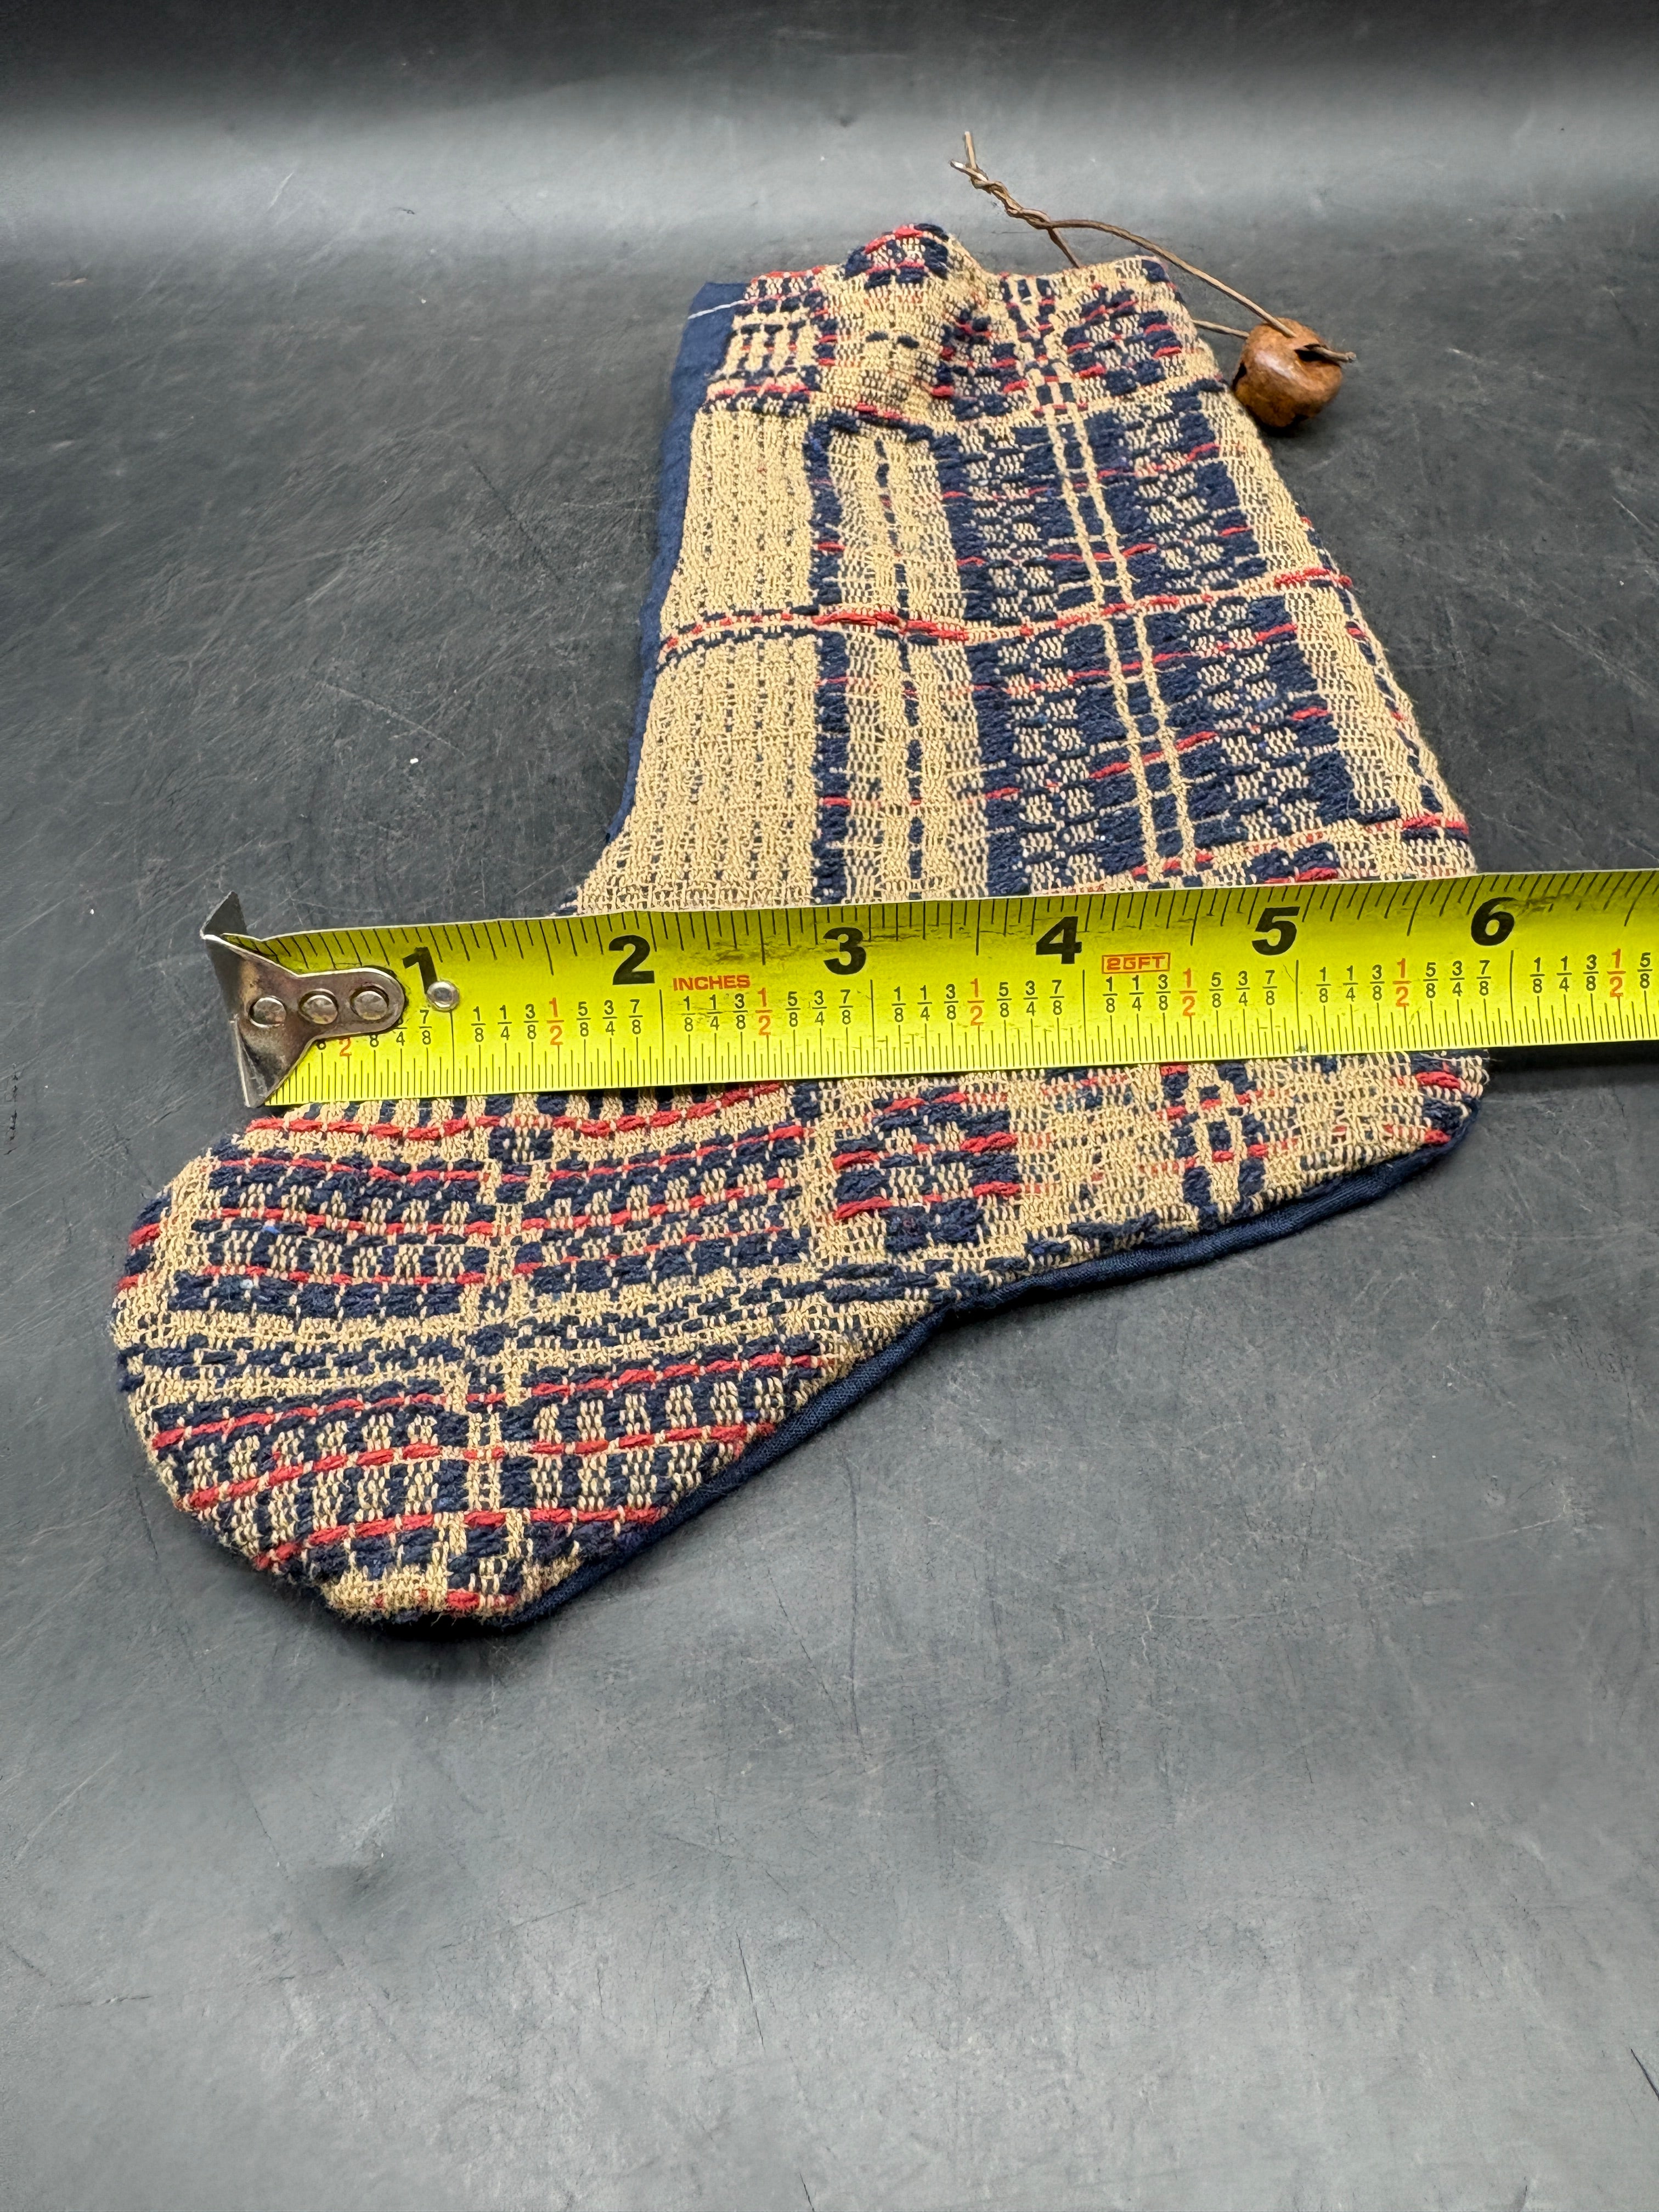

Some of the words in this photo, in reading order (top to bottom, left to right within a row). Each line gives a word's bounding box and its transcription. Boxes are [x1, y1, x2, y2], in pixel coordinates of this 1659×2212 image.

[402, 946, 439, 993] 1
[608, 934, 655, 985] 2
[823, 927, 867, 975] 3
[1035, 916, 1082, 964] 4
[1251, 906, 1300, 955] 5
[1470, 896, 1516, 946] 6
[1107, 955, 1165, 970] 25FT
[673, 974, 751, 990] INCHES
